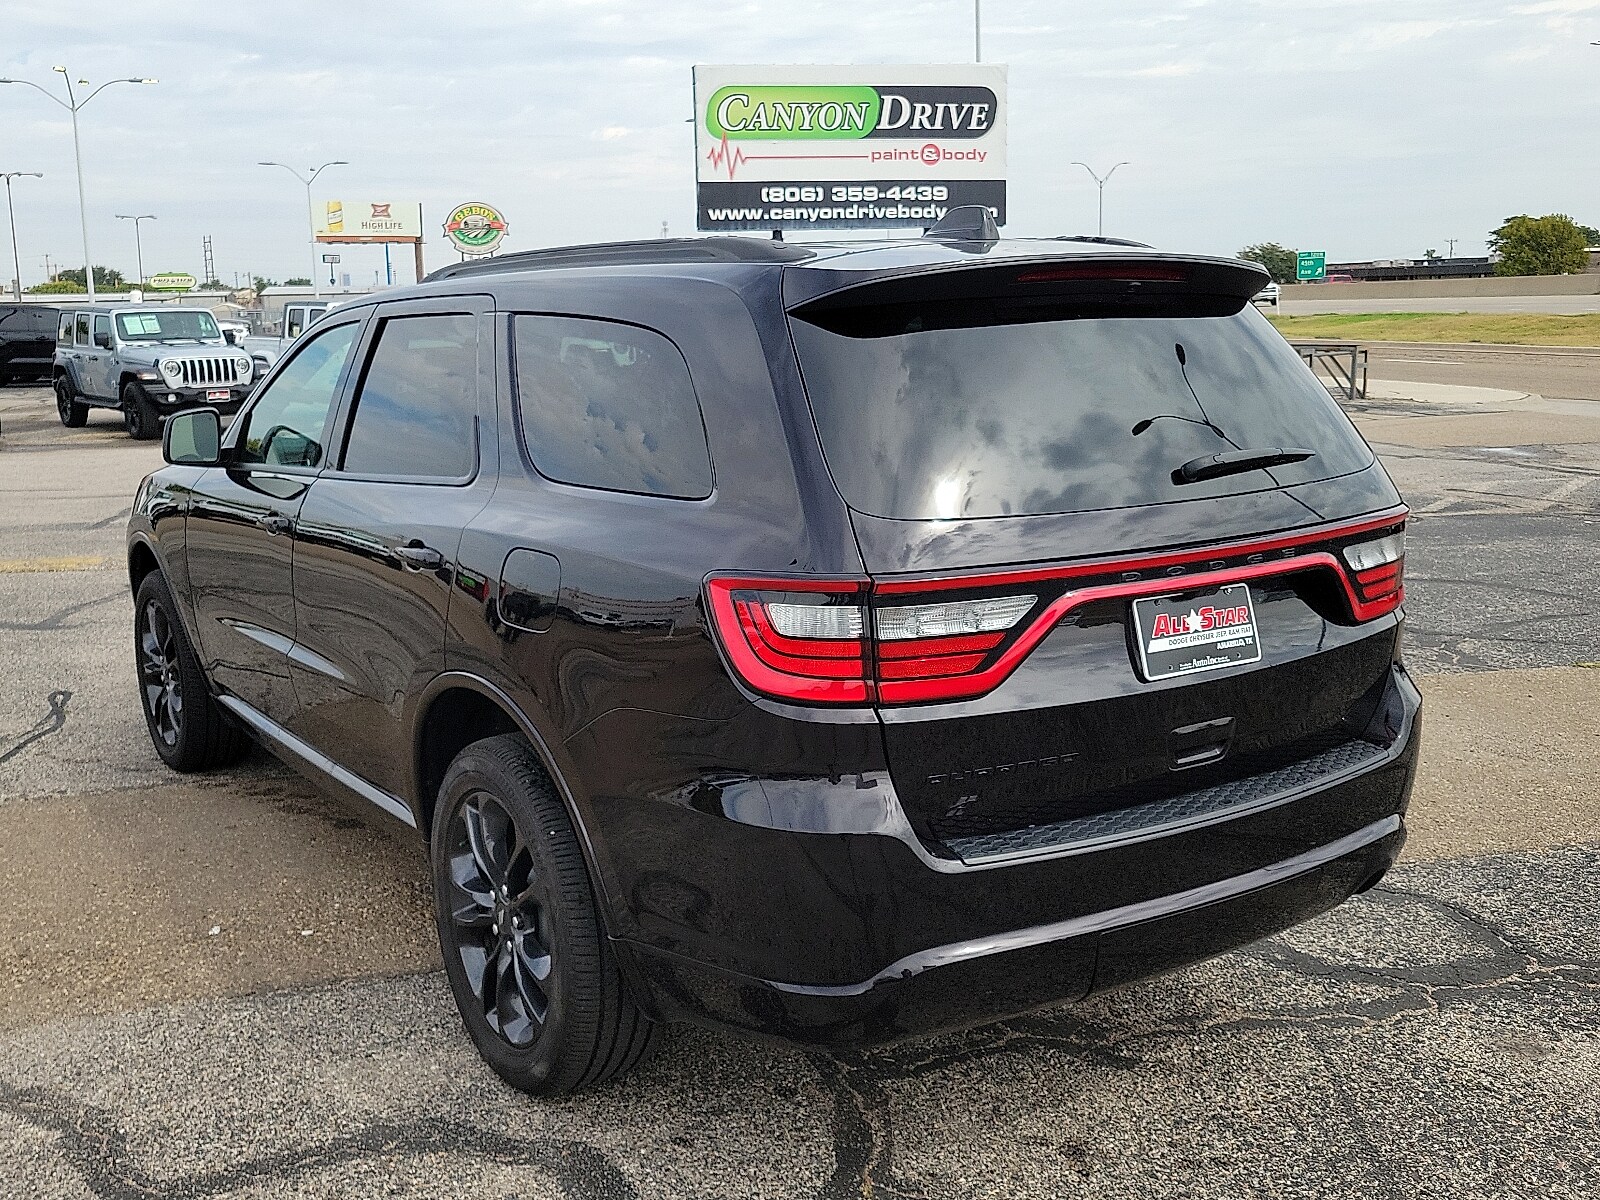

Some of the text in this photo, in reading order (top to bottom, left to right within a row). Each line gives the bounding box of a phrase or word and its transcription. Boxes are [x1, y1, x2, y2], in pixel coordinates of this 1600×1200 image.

[760, 186, 949, 203] (806) 359-4439
[1121, 548, 1296, 582] DODGE
[1198, 606, 1250, 631] STAR
